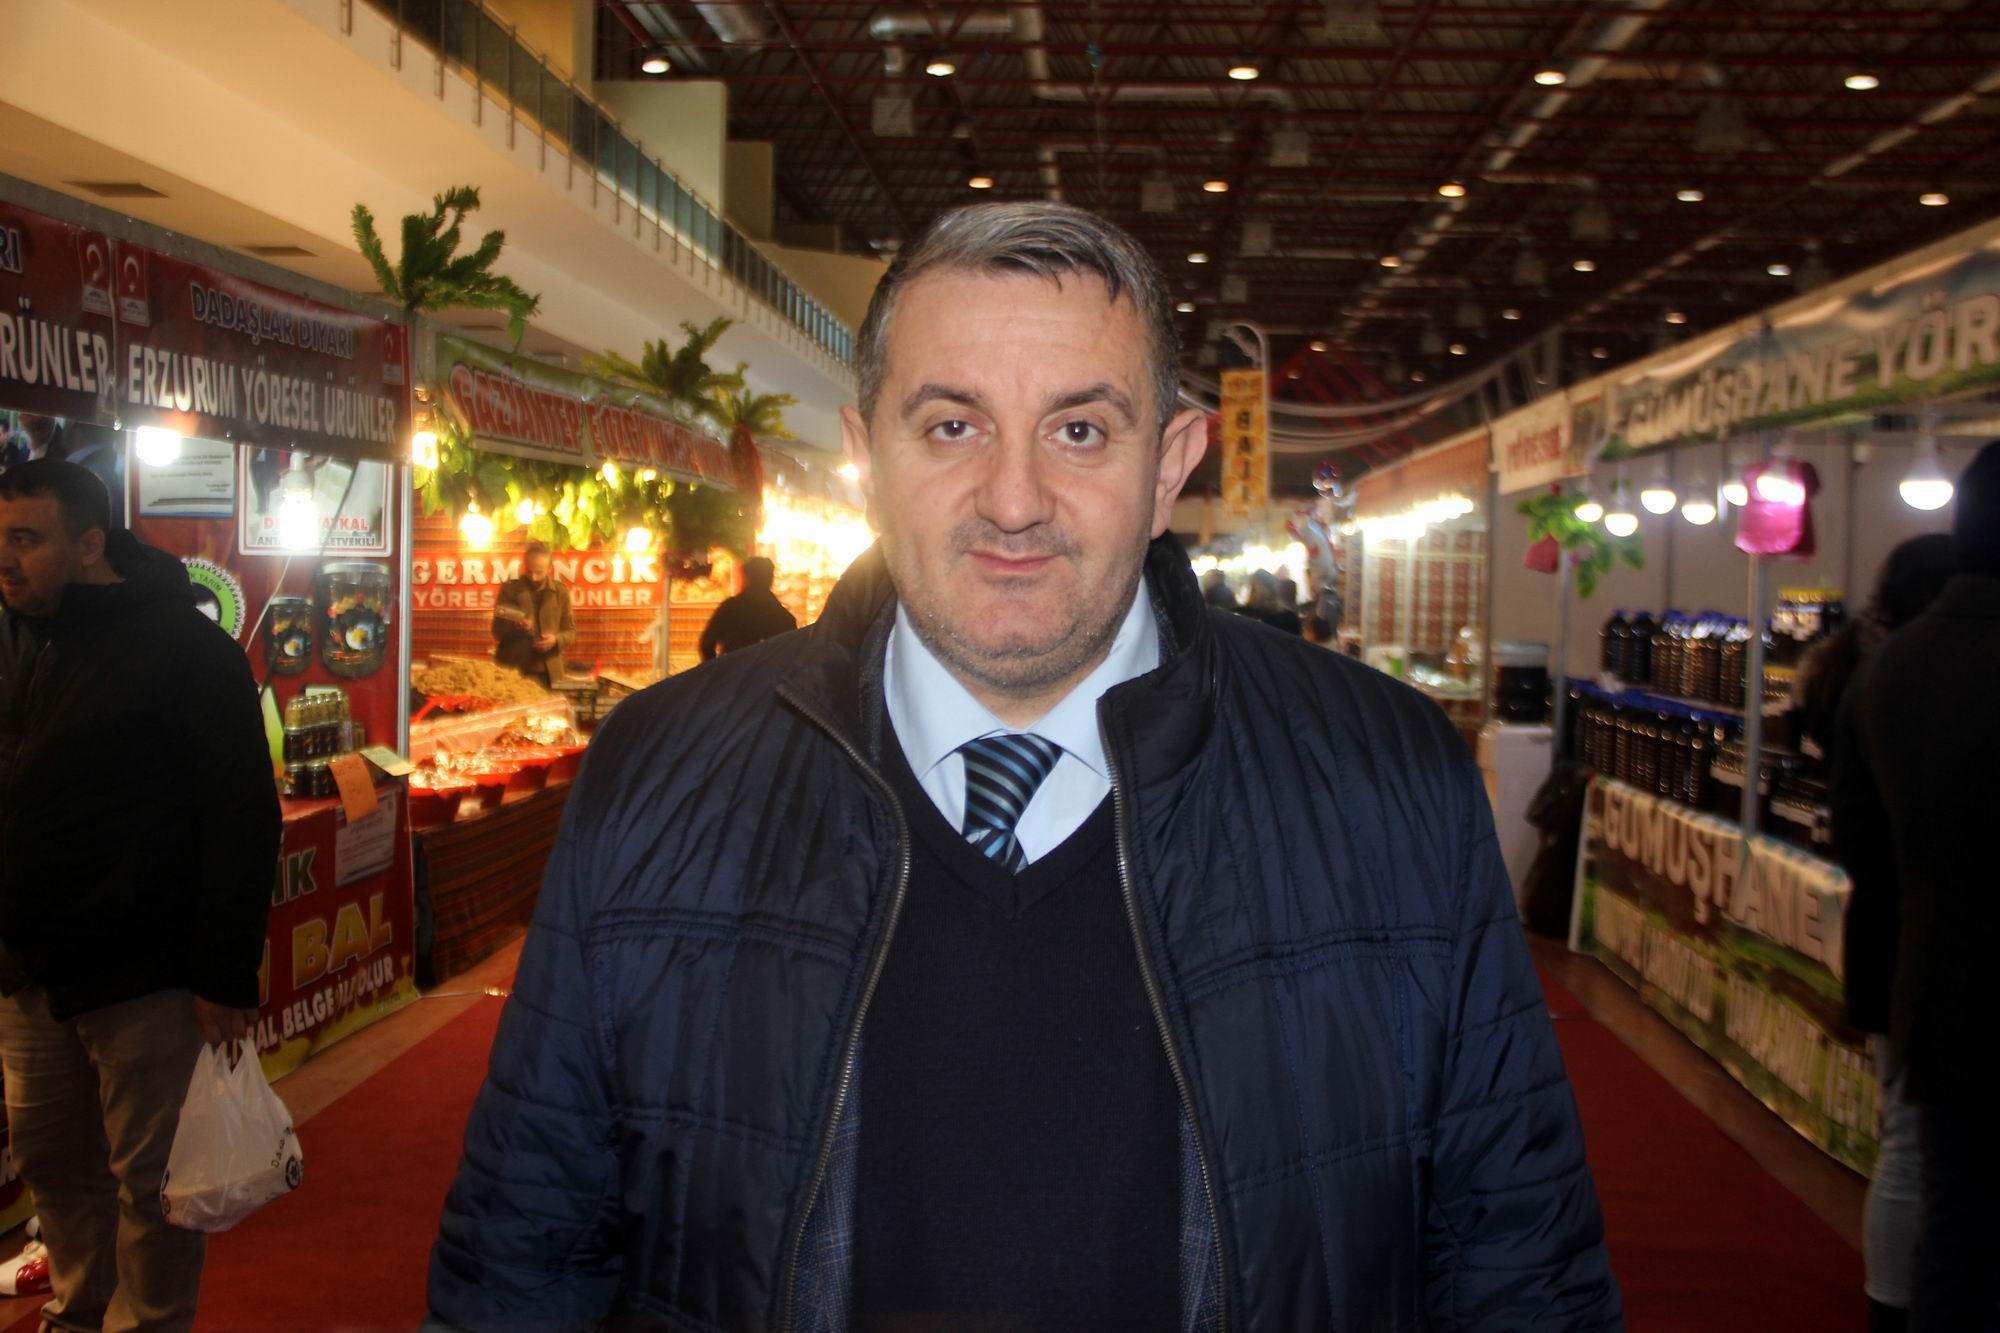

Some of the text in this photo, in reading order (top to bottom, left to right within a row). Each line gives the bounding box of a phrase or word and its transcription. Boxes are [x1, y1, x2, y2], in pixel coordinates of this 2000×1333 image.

[190, 283, 295, 345] DADAŞLAR
[128, 343, 397, 444] ERZURUM YÖRESEL ÜRÜNLER
[412, 553, 658, 584] GERMNCİK
[414, 586, 652, 608] YÖRES ÜNLER
[294, 893, 392, 990] BAL
